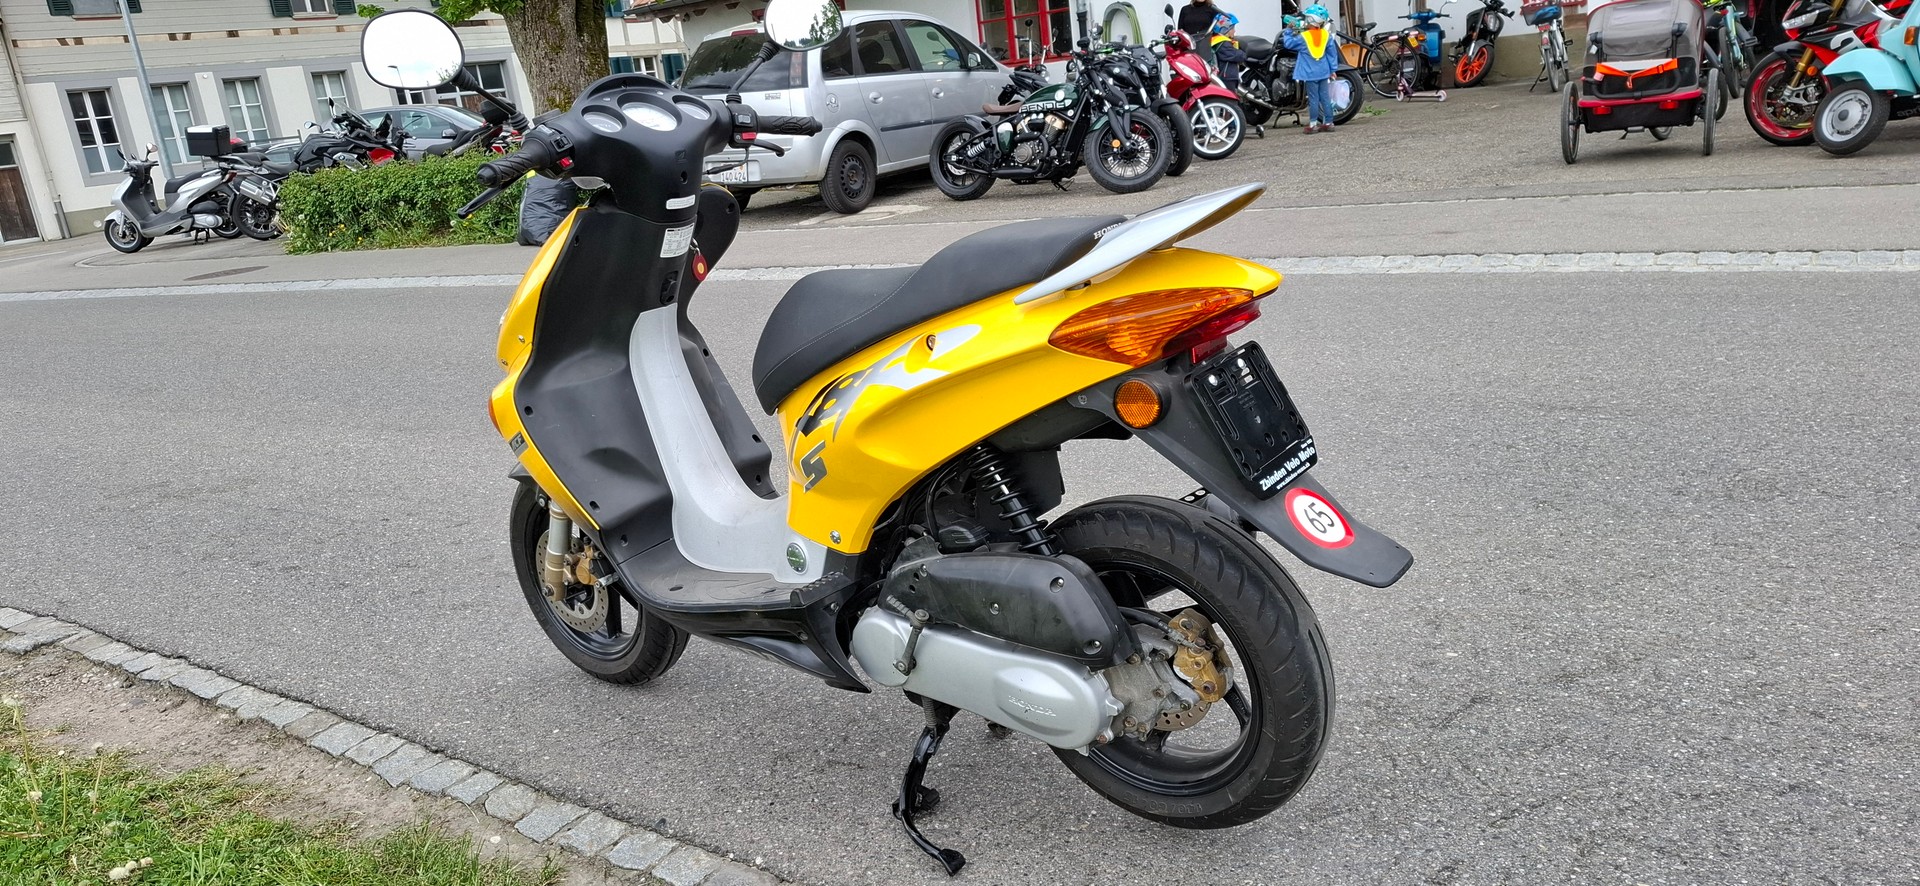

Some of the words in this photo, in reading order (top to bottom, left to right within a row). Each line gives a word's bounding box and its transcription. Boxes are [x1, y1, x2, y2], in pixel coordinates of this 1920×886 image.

[1259, 467, 1288, 491] Zbinden
[1283, 457, 1301, 472] Velo
[1297, 446, 1316, 463] Moto
[1303, 502, 1335, 534] 65
[1008, 695, 1057, 717] HONDA
